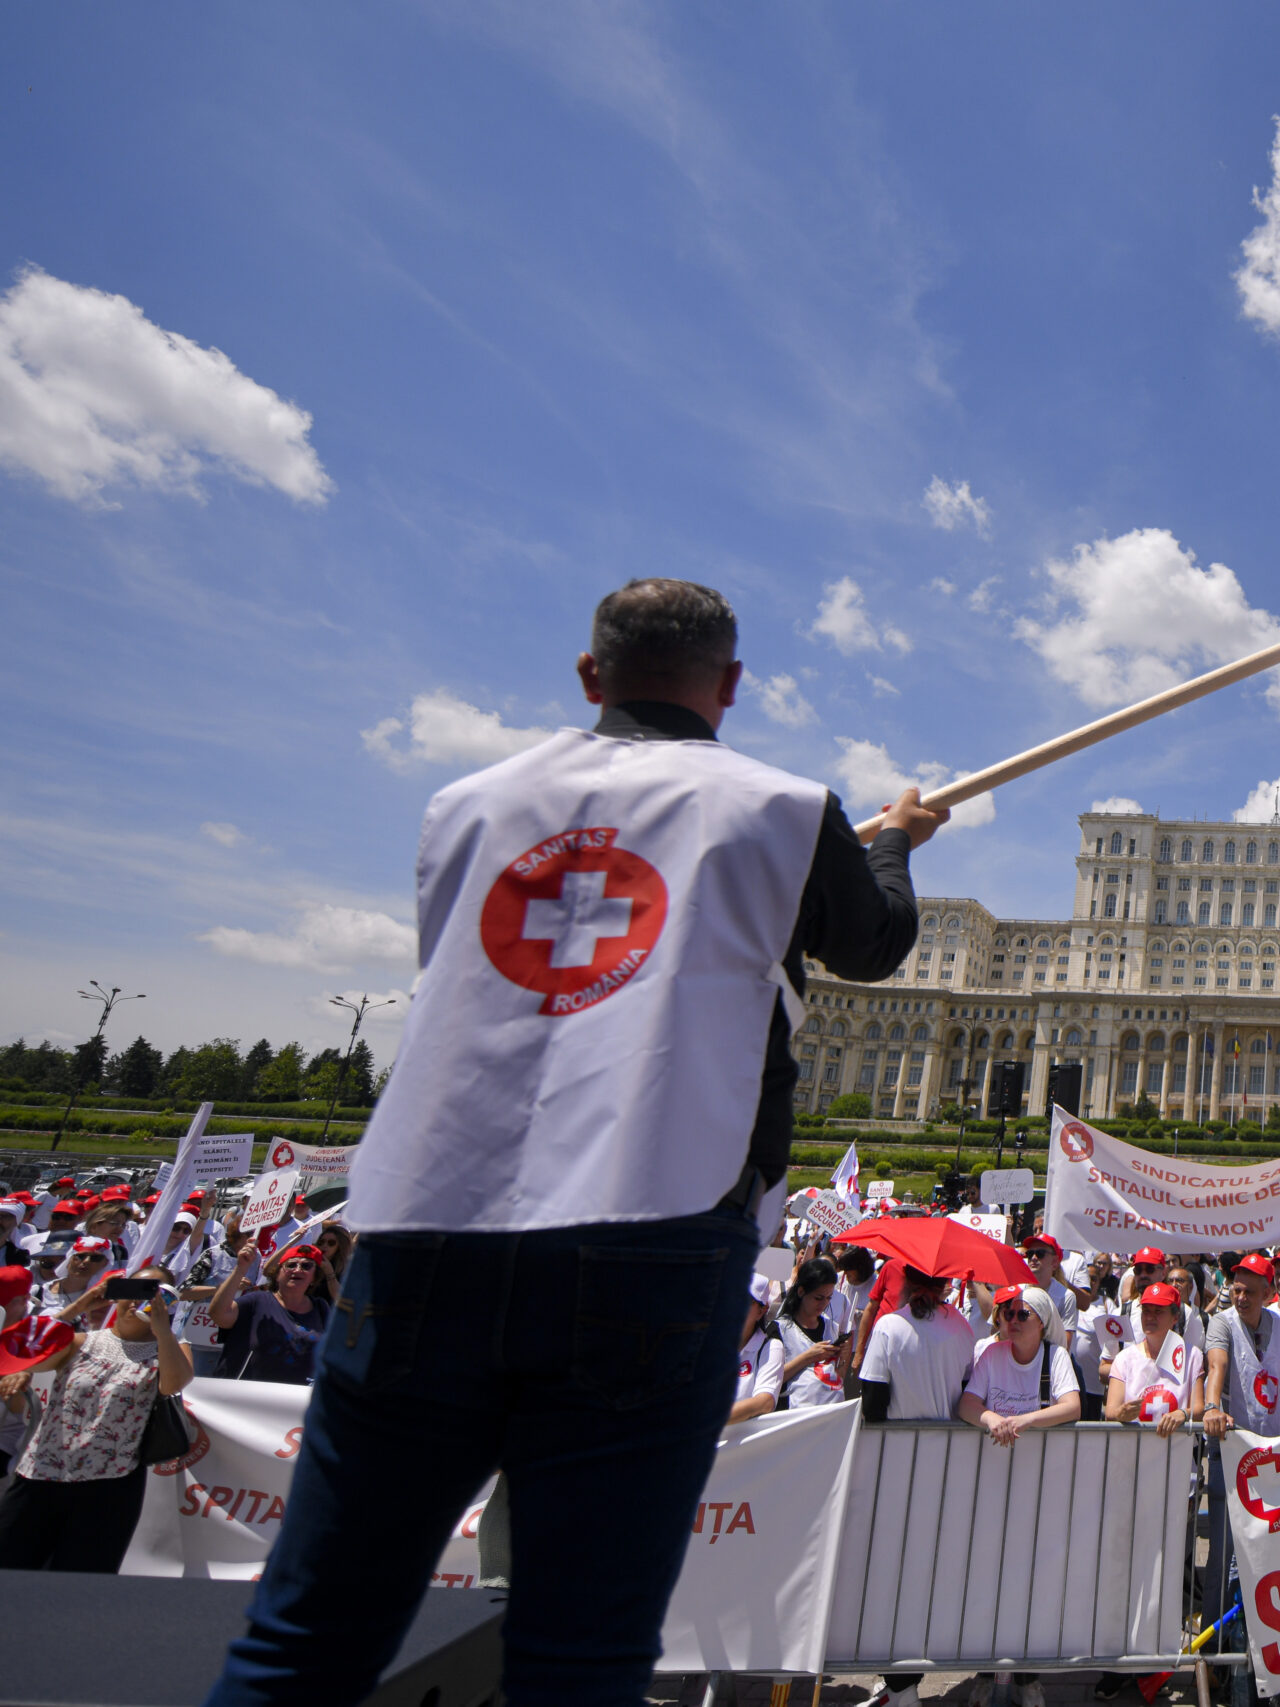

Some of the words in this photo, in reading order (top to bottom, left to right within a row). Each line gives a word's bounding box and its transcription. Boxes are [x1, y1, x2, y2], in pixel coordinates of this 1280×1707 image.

[514, 831, 607, 876] SANITAS
[552, 949, 648, 1013] ROMÂNIA
[1088, 1167, 1176, 1206] SPITALUL
[1180, 1191, 1249, 1209] CLINIC
[1131, 1160, 1254, 1188] SINDICATUL
[242, 1208, 282, 1227] BUCUREȘTI
[247, 1194, 287, 1216] SANITAS
[815, 1201, 852, 1231] SANITAS
[1240, 1448, 1270, 1475] SANITAS
[179, 1483, 285, 1527] SPITA
